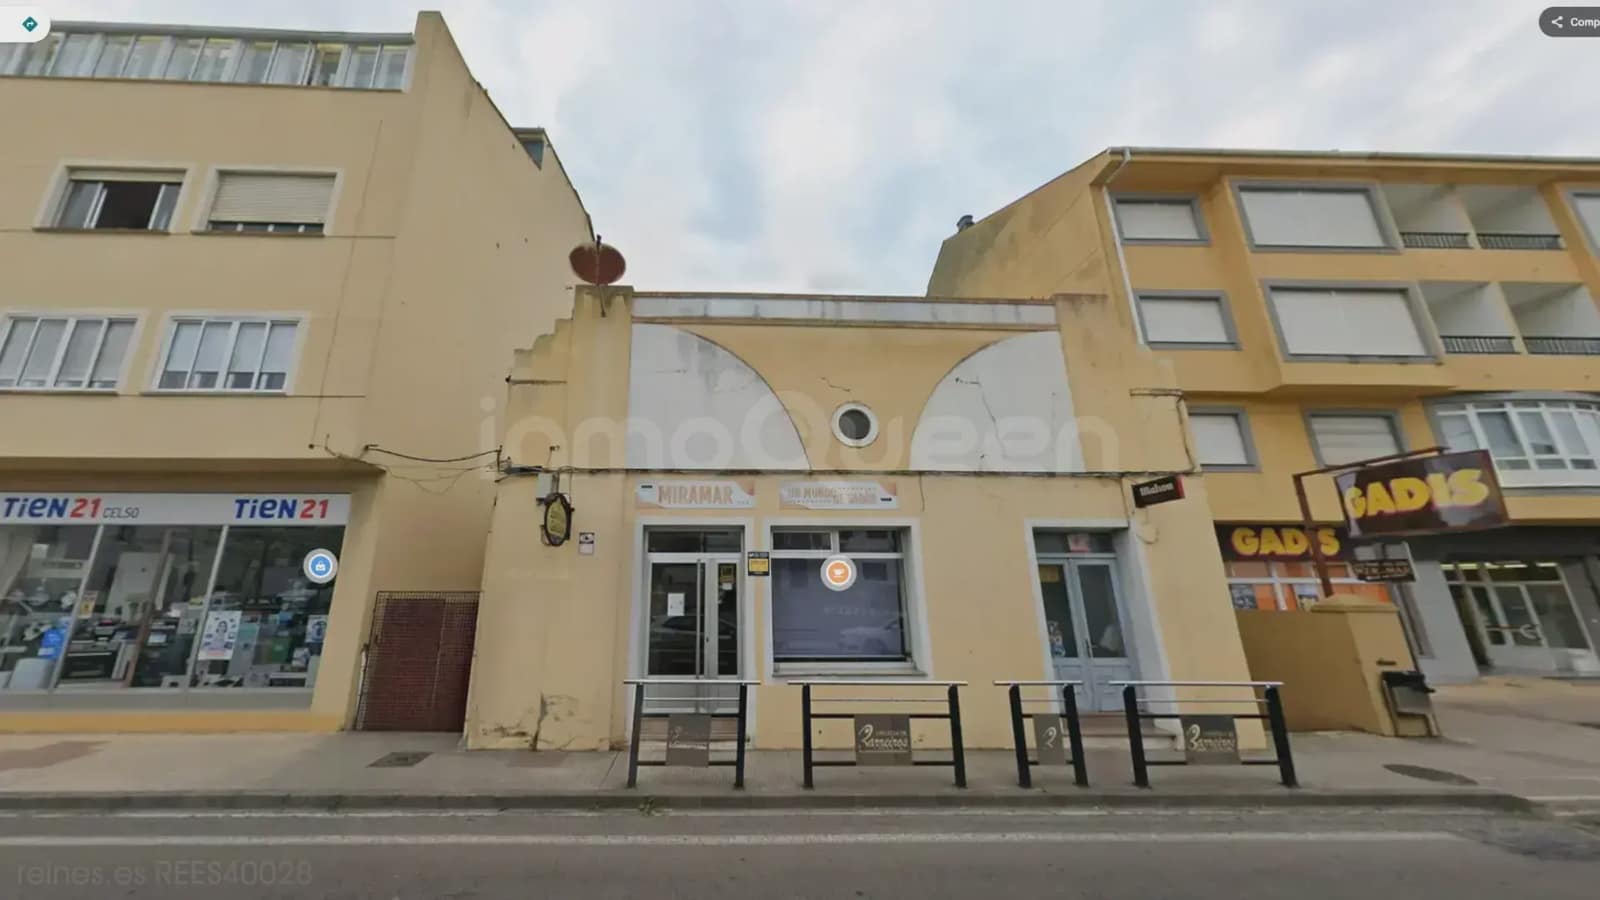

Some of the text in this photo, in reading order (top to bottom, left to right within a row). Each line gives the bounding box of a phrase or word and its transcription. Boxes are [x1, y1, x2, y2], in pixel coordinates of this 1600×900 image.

[657, 485, 733, 504] MIRAMAR
[1345, 468, 1489, 519] GADIS
[70, 497, 102, 518] 21
[103, 507, 139, 518] CELSO
[300, 499, 329, 519] 21
[1231, 527, 1340, 557] GADS
